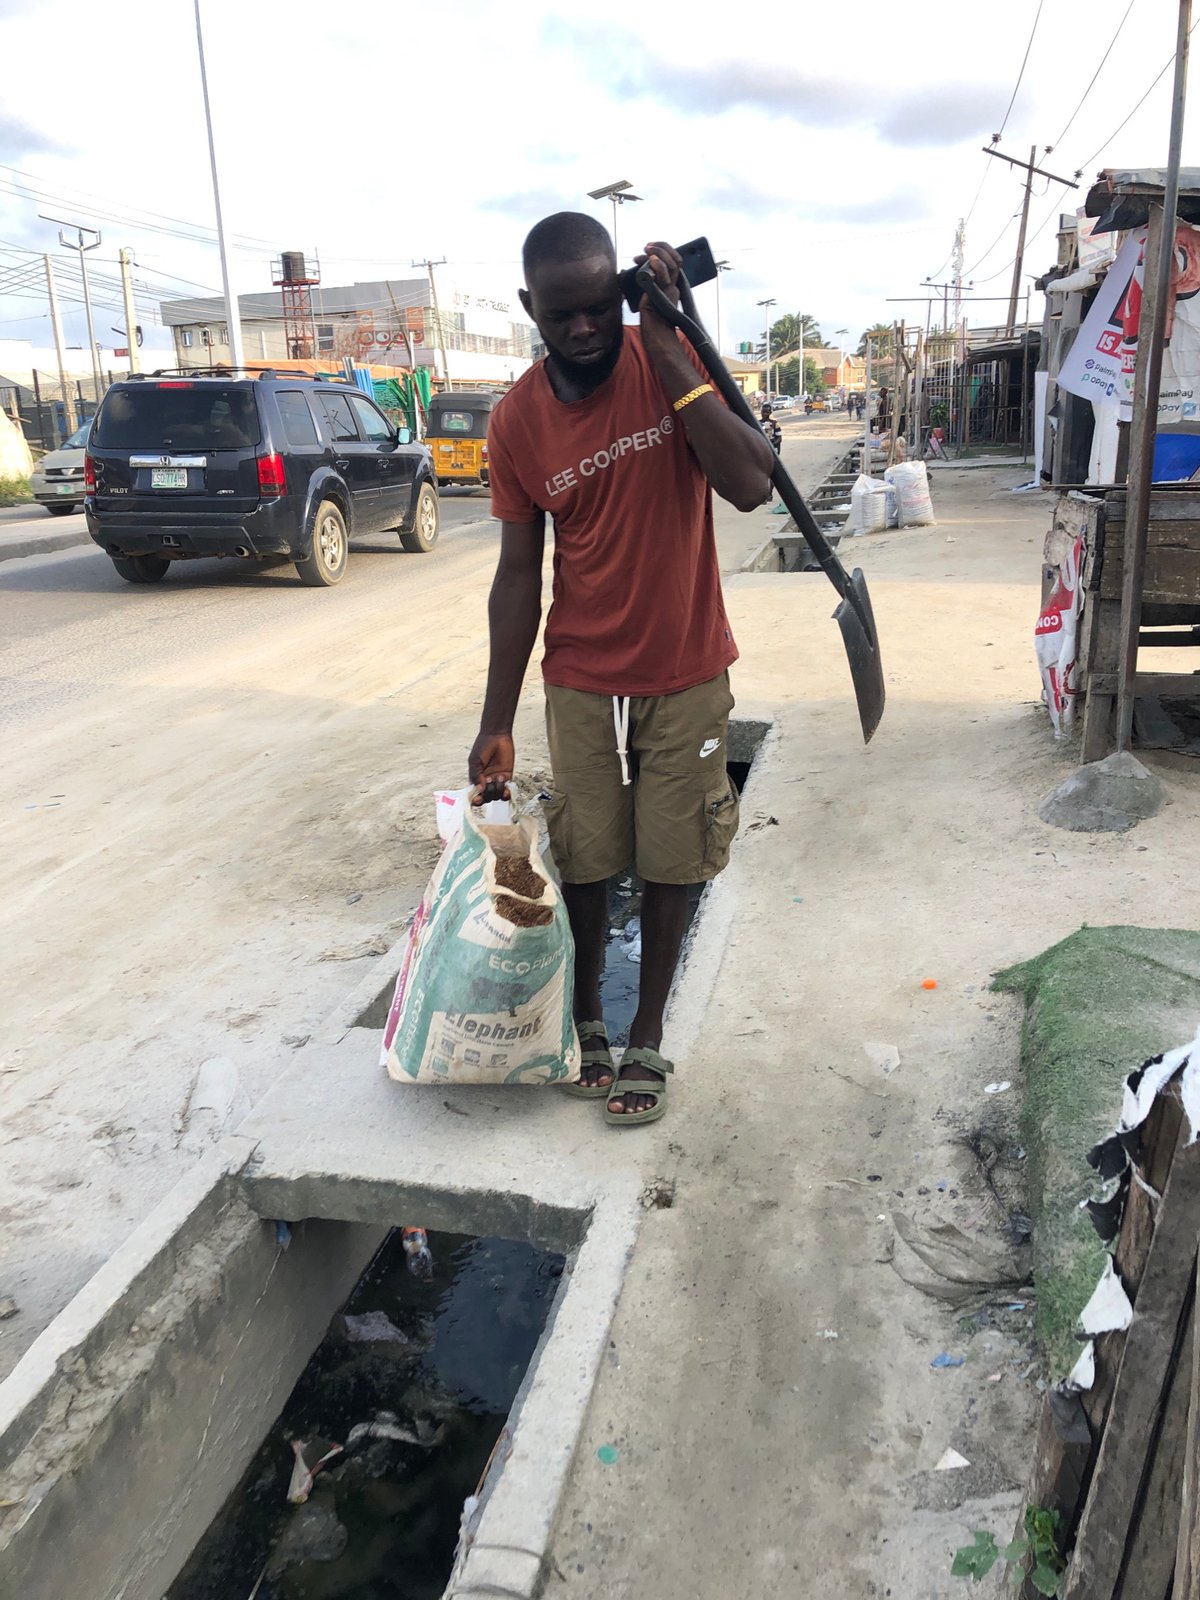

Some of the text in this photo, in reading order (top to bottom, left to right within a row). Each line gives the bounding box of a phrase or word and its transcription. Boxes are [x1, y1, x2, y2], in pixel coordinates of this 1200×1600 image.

[1099, 334, 1116, 351] IS
[545, 467, 579, 497] LEE
[445, 1004, 542, 1041] Elephant
